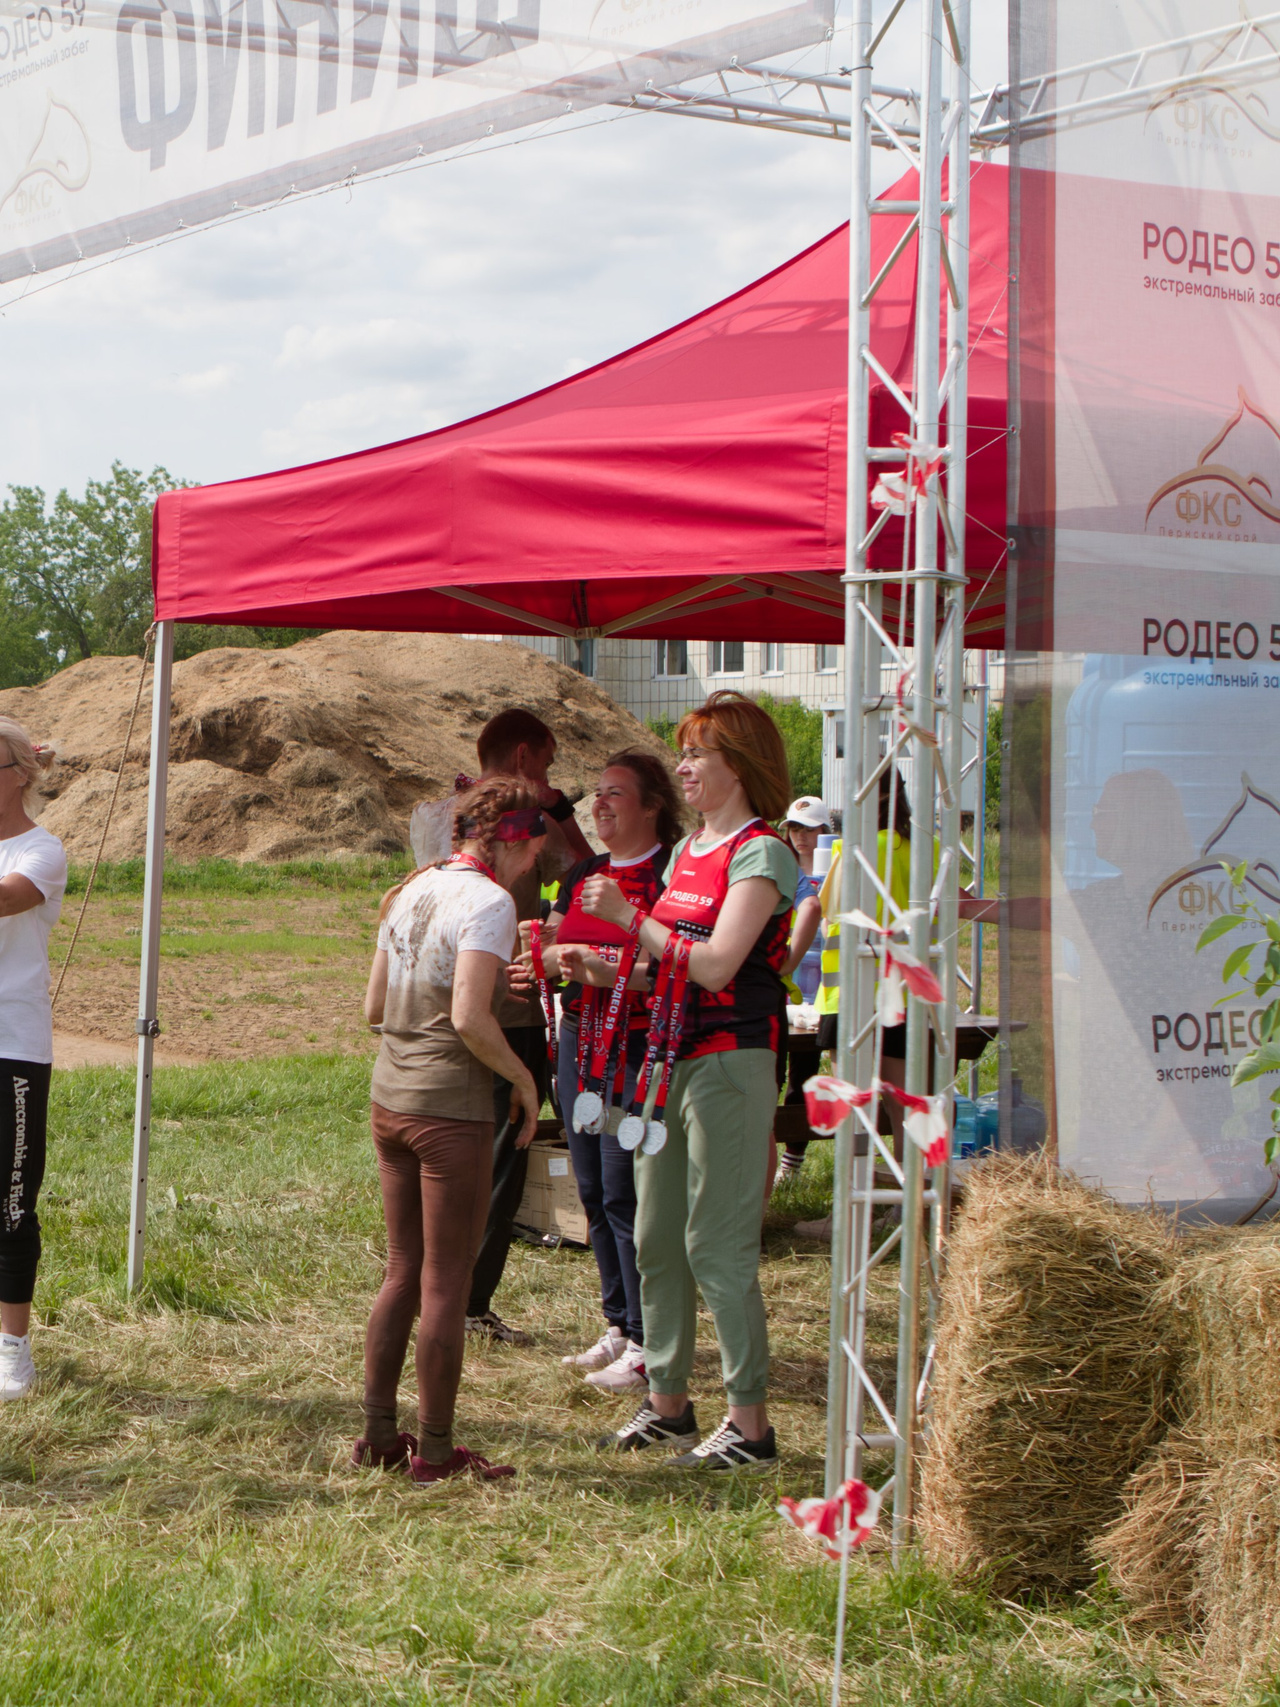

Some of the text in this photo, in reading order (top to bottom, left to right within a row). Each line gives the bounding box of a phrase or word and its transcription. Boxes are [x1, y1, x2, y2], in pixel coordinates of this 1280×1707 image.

[61, 0, 86, 33] 59
[61, 39, 89, 62] забег
[1174, 98, 1238, 141] ФКС
[15, 179, 53, 216] ФКС
[1143, 221, 1255, 276] РОДЕО
[1143, 275, 1255, 303] экстремальный
[1175, 489, 1241, 528] ФКС
[1159, 526, 1222, 540] Пермский
[1143, 618, 1259, 665] РОДЕО
[1143, 671, 1259, 690] экстремальный
[670, 890, 699, 903] РОДЕО
[698, 896, 714, 907] 59
[1178, 881, 1247, 916] ФКС
[581, 1003, 590, 1037] РОДЕО
[605, 975, 626, 1030] РОДЕО 59
[650, 995, 662, 1034] РОДЕО
[669, 1002, 681, 1041] РОДЕО
[648, 1045, 658, 1059] 59
[8, 1075, 30, 1222] Abercrombie & Fitch
